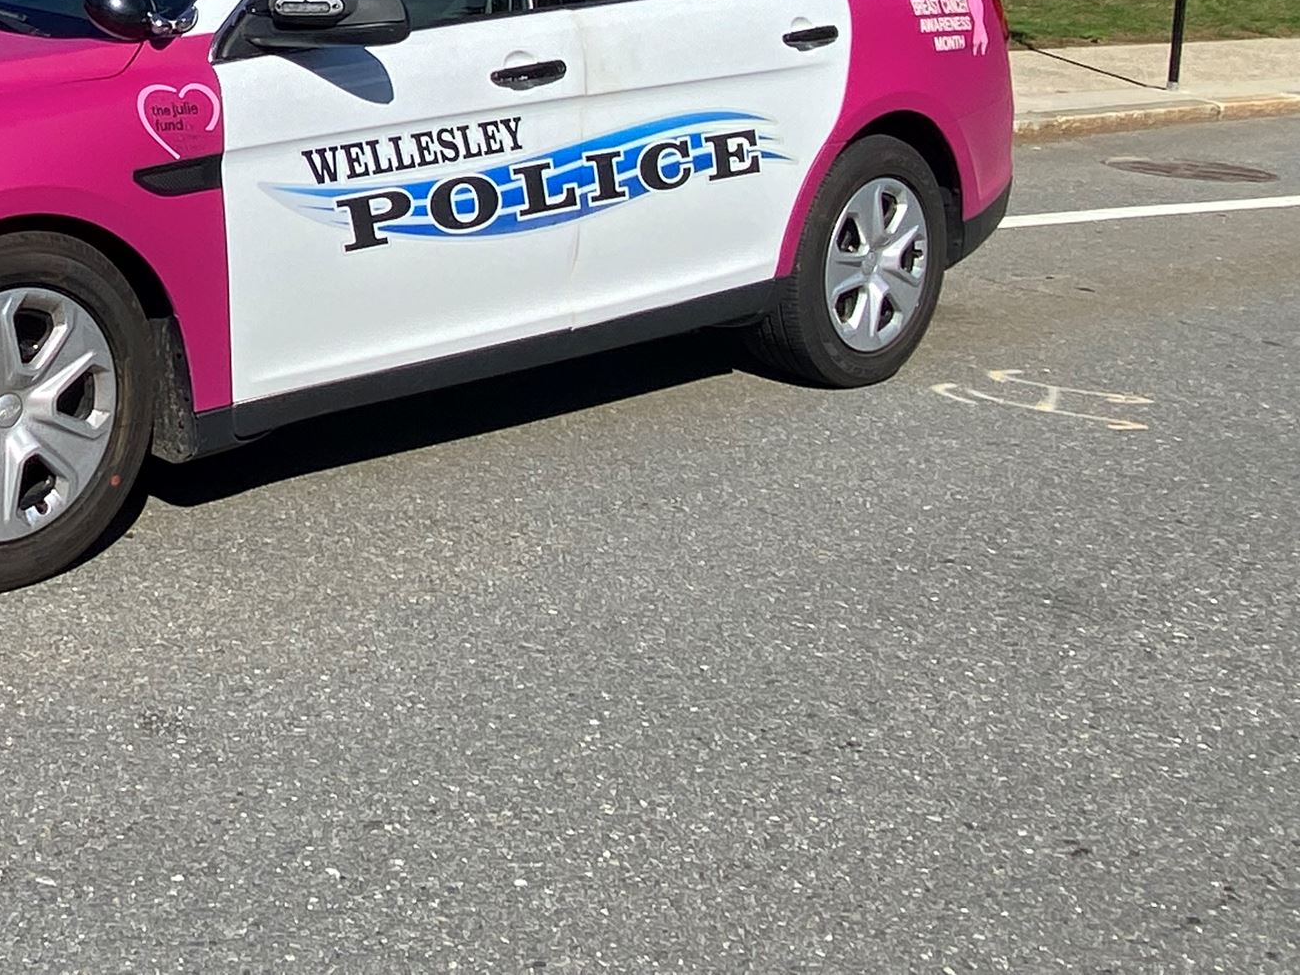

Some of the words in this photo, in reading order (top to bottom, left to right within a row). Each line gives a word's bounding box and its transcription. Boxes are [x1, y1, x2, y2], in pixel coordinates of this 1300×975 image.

[920, 16, 972, 33] AWARENESS
[933, 35, 966, 52] MONTH
[152, 104, 171, 116] the
[172, 102, 198, 117] julie
[155, 119, 184, 132] fund
[301, 116, 524, 185] WELLESLEY
[335, 128, 763, 253] POLICE
